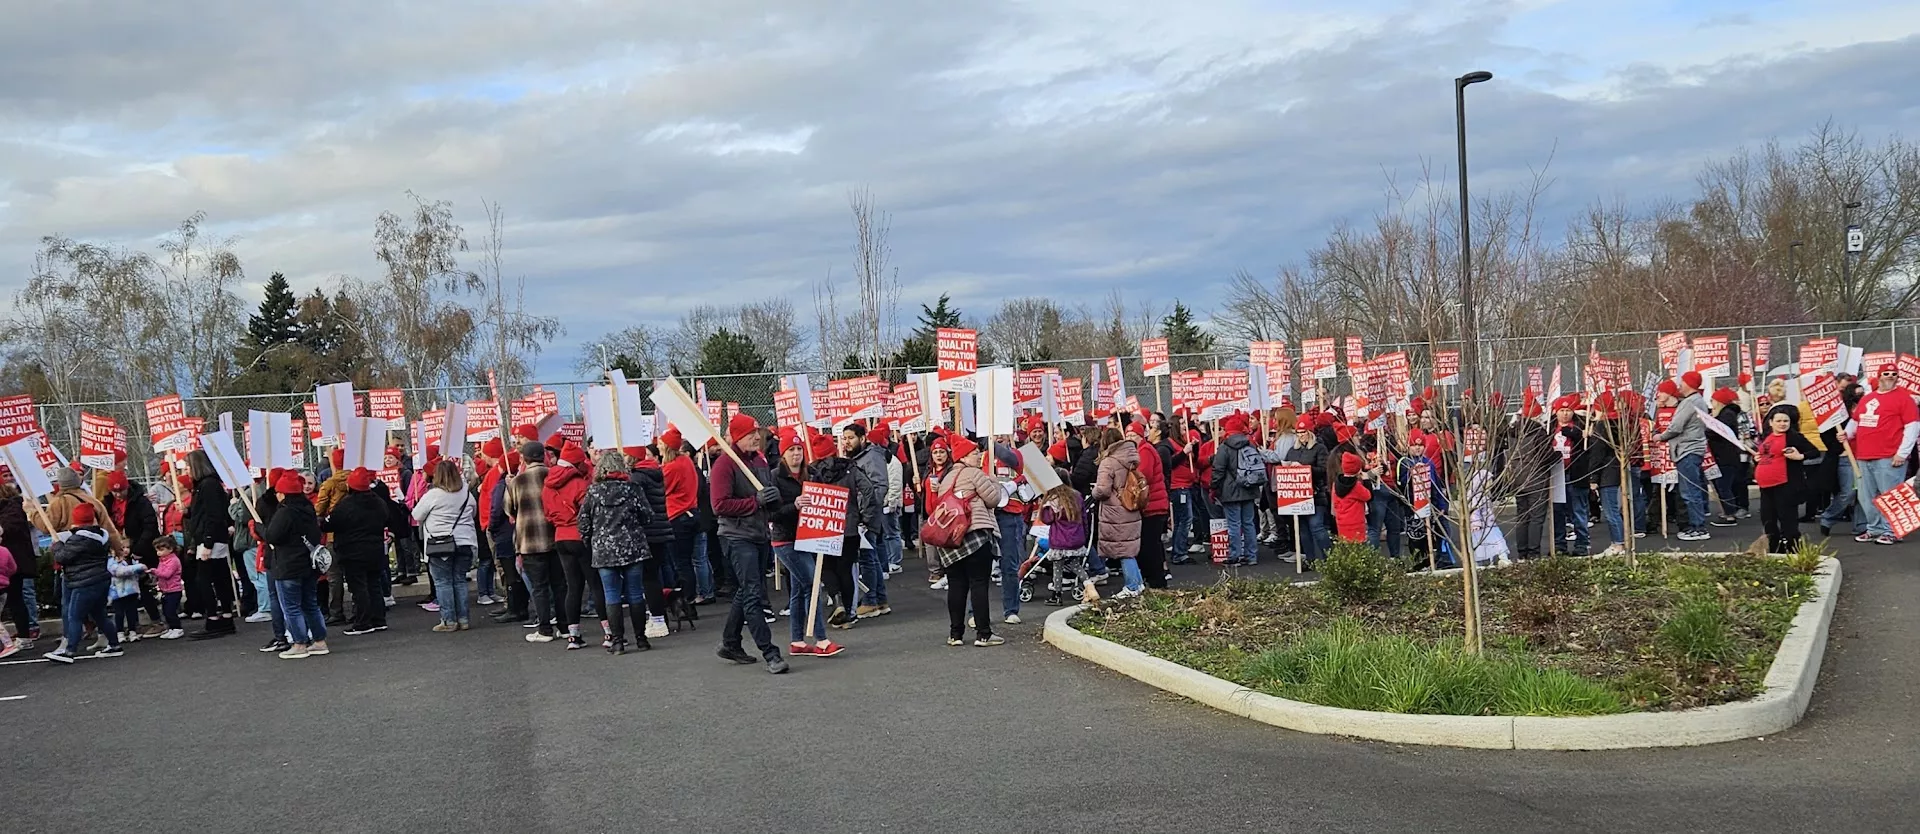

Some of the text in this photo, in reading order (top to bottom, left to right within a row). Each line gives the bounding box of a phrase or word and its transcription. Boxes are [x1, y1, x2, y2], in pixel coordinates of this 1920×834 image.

[939, 340, 975, 350] QUALITY
[1694, 342, 1727, 351] QUALITY
[939, 350, 976, 359] EDUCATION
[939, 360, 975, 372] FOR ALL
[850, 383, 878, 393] QUALITY
[1898, 379, 1908, 389] OR
[1807, 381, 1837, 403] QUALITY
[1810, 390, 1839, 410] EDUCATION
[0, 404, 32, 418] ALITY
[1068, 402, 1083, 410] ALL
[1813, 398, 1844, 418] FOR ALL
[837, 408, 851, 416] ALL
[905, 408, 921, 417] ALL
[1, 415, 34, 426] UCATION
[787, 416, 800, 425] ALL
[0, 424, 37, 437] OR ALL
[150, 421, 185, 435] FOR ALL
[81, 438, 114, 453] FOR ALL
[40, 454, 56, 464] LL
[1277, 474, 1311, 482] QUALITY
[824, 488, 848, 498] DEMANDS
[1278, 490, 1293, 498] FOR
[1901, 483, 1919, 502] ALL
[801, 506, 846, 520] EDUCATION
[1882, 494, 1913, 532] QUALITY
[799, 516, 844, 533] FOR ALL
